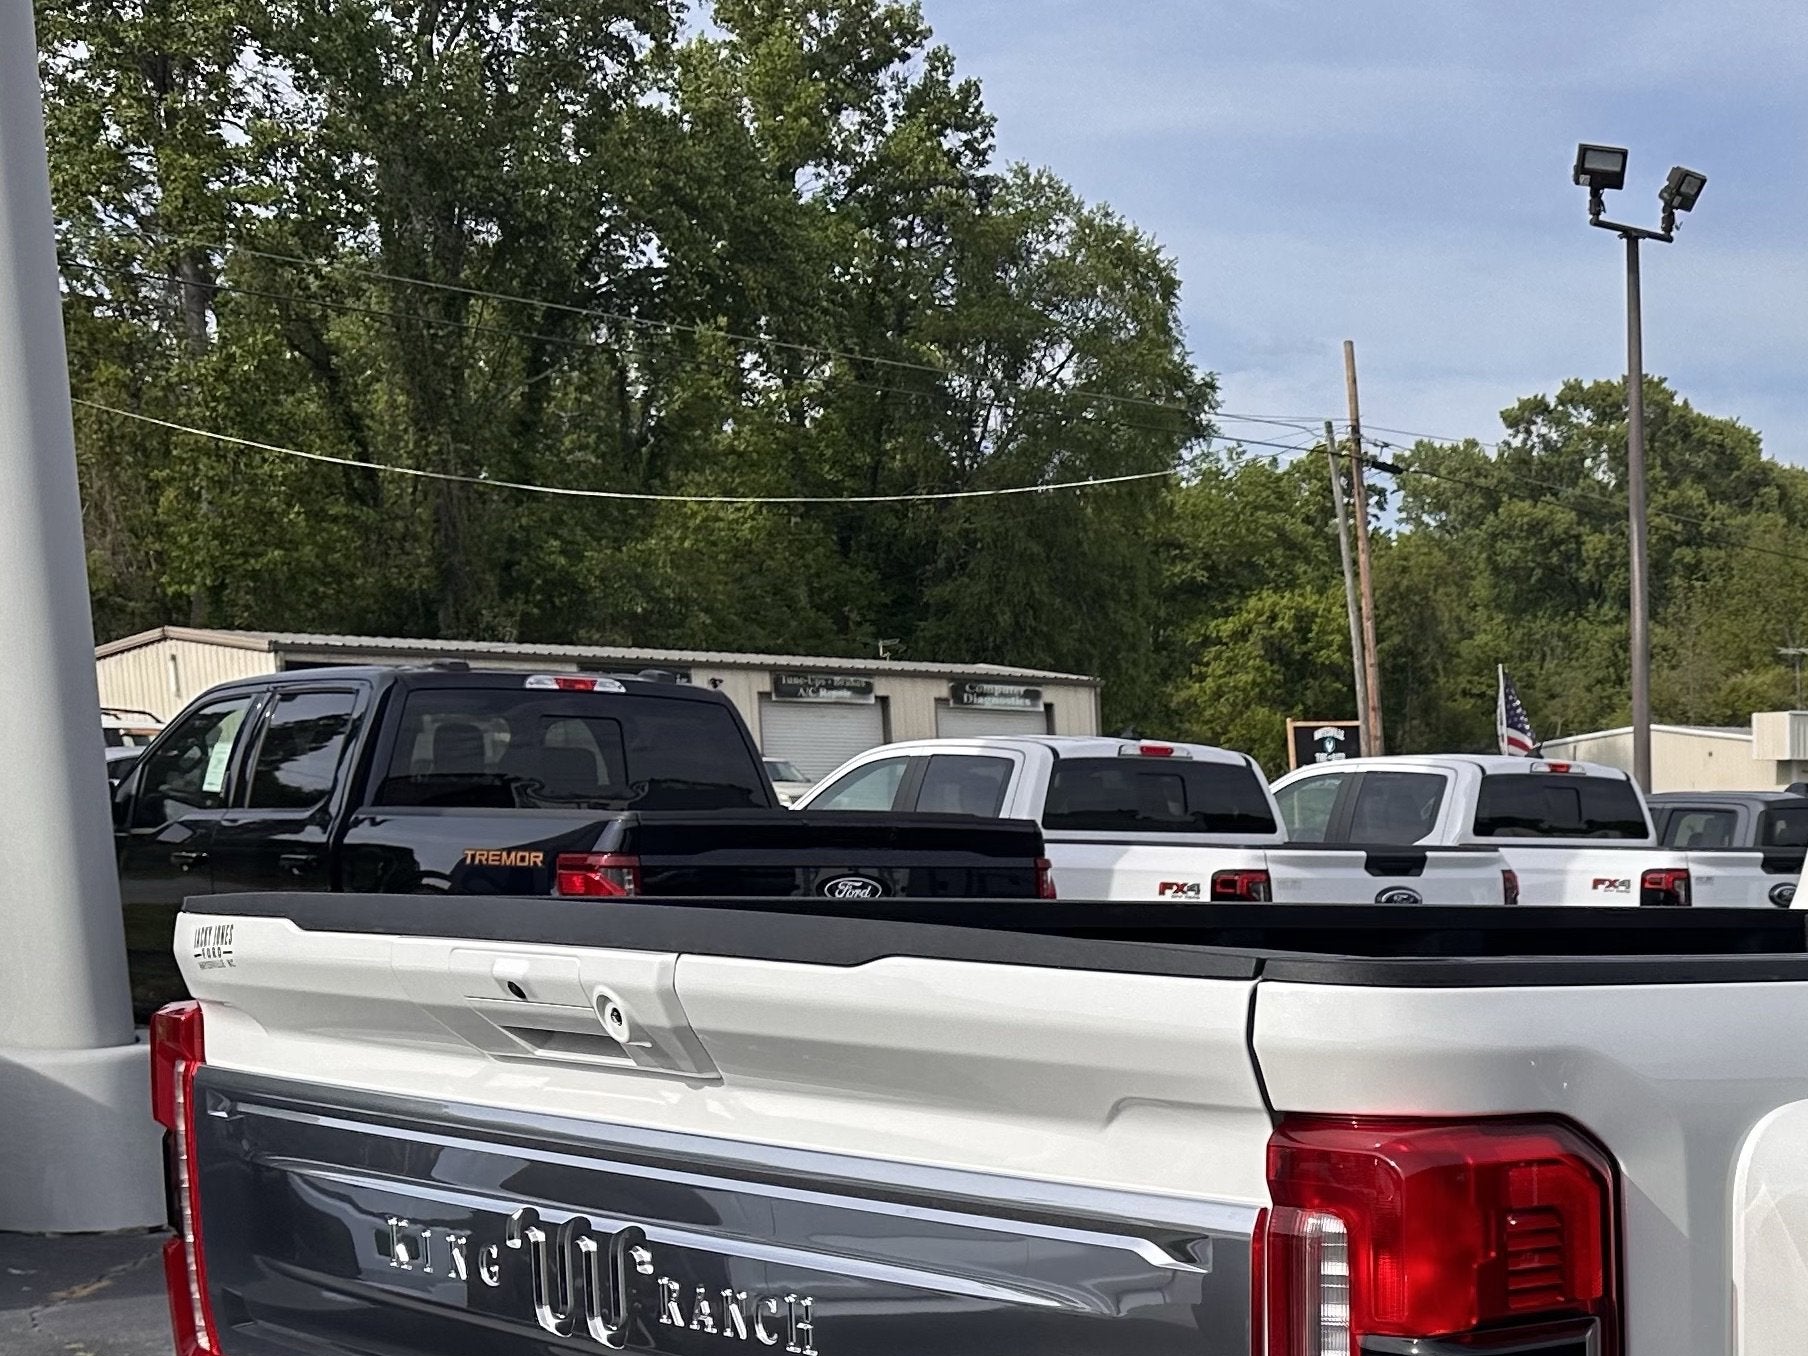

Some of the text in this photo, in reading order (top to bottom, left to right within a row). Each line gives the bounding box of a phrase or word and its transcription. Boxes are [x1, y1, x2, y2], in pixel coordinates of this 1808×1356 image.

[463, 850, 544, 867] TREMOR
[834, 881, 871, 898] Ford
[1158, 881, 1200, 896] FX4
[1592, 878, 1632, 891] FX4
[387, 1215, 819, 1356] KING RANCH
